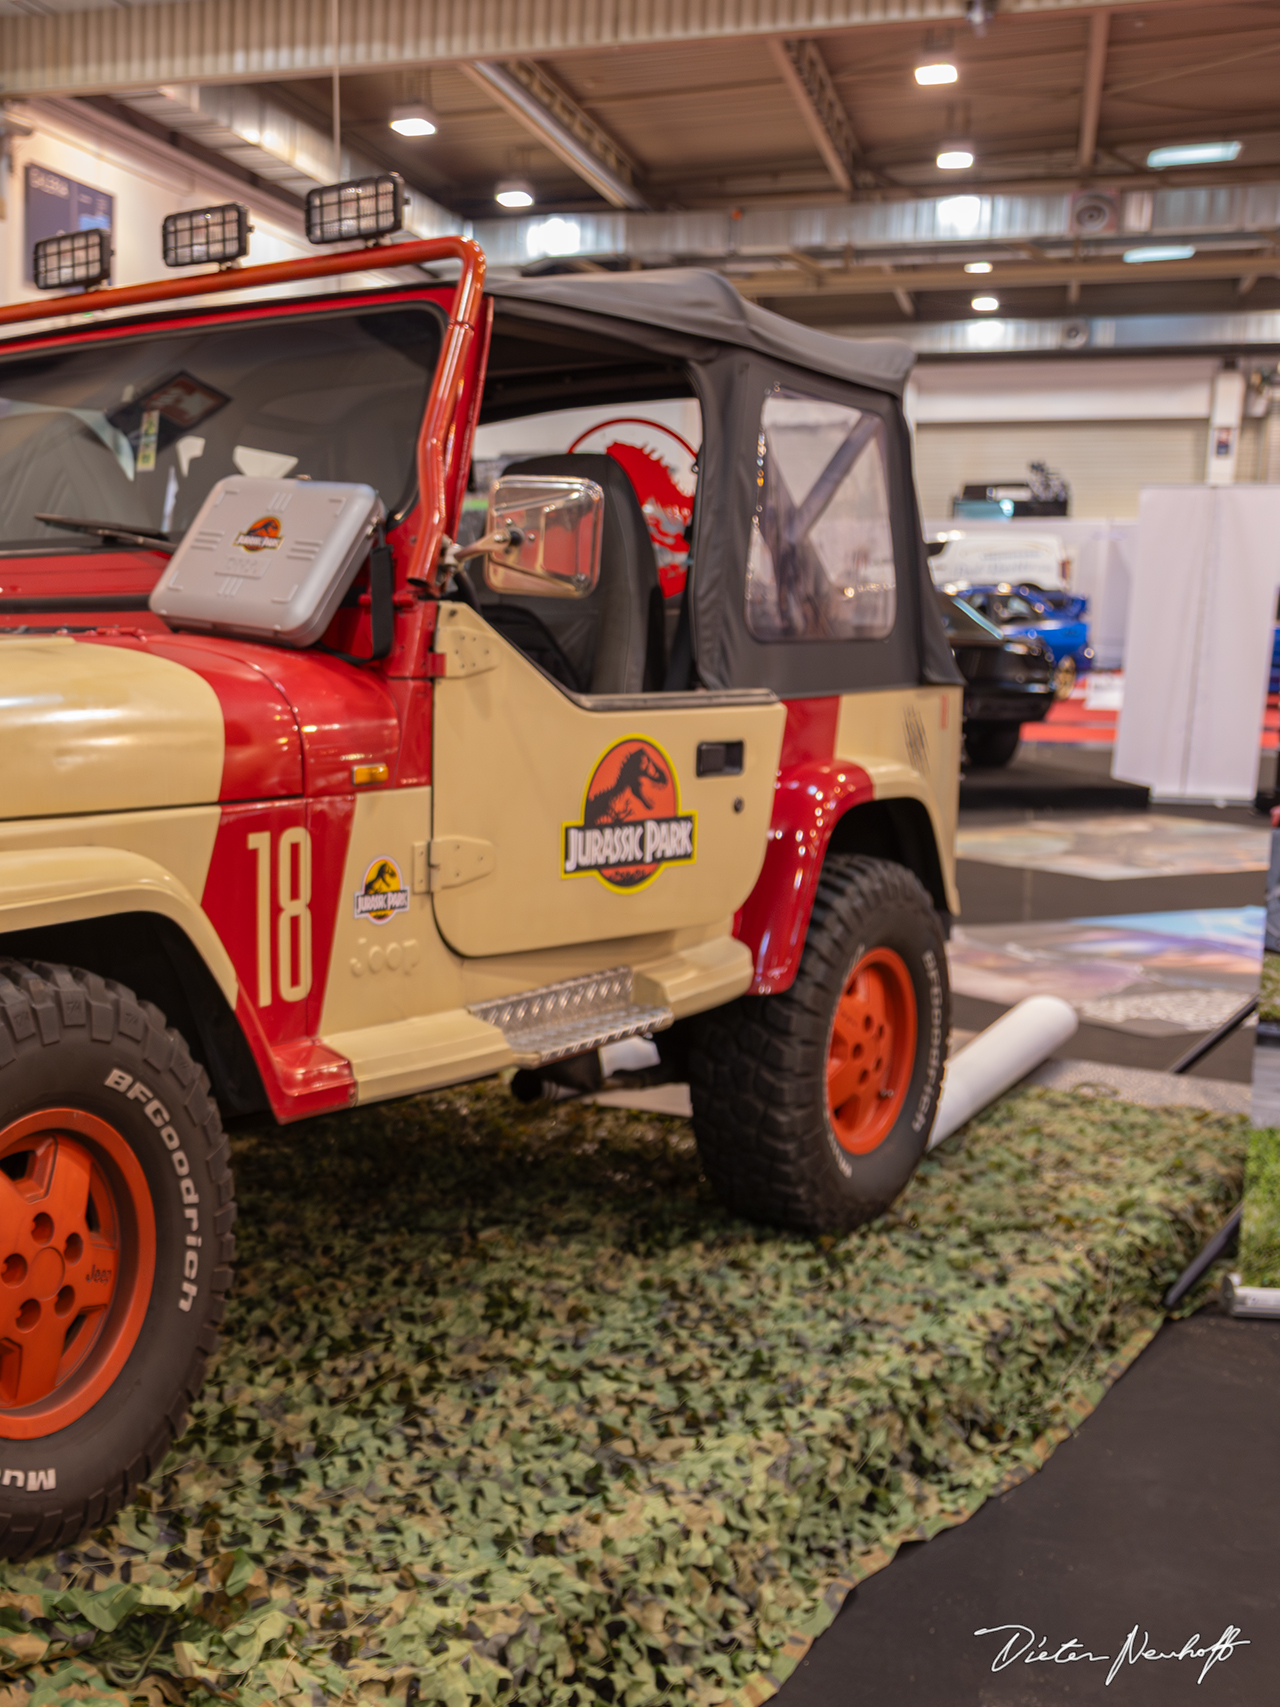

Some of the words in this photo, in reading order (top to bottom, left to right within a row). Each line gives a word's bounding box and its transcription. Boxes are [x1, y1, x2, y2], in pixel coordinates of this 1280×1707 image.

[247, 826, 313, 1008] 18
[357, 894, 387, 914] JURASSIC
[387, 891, 408, 910] PARK
[564, 825, 644, 872] JURASSIC
[644, 819, 693, 864] PARK
[912, 950, 943, 1133] BFGoodrich
[104, 1067, 202, 1313] BFGoodrich
